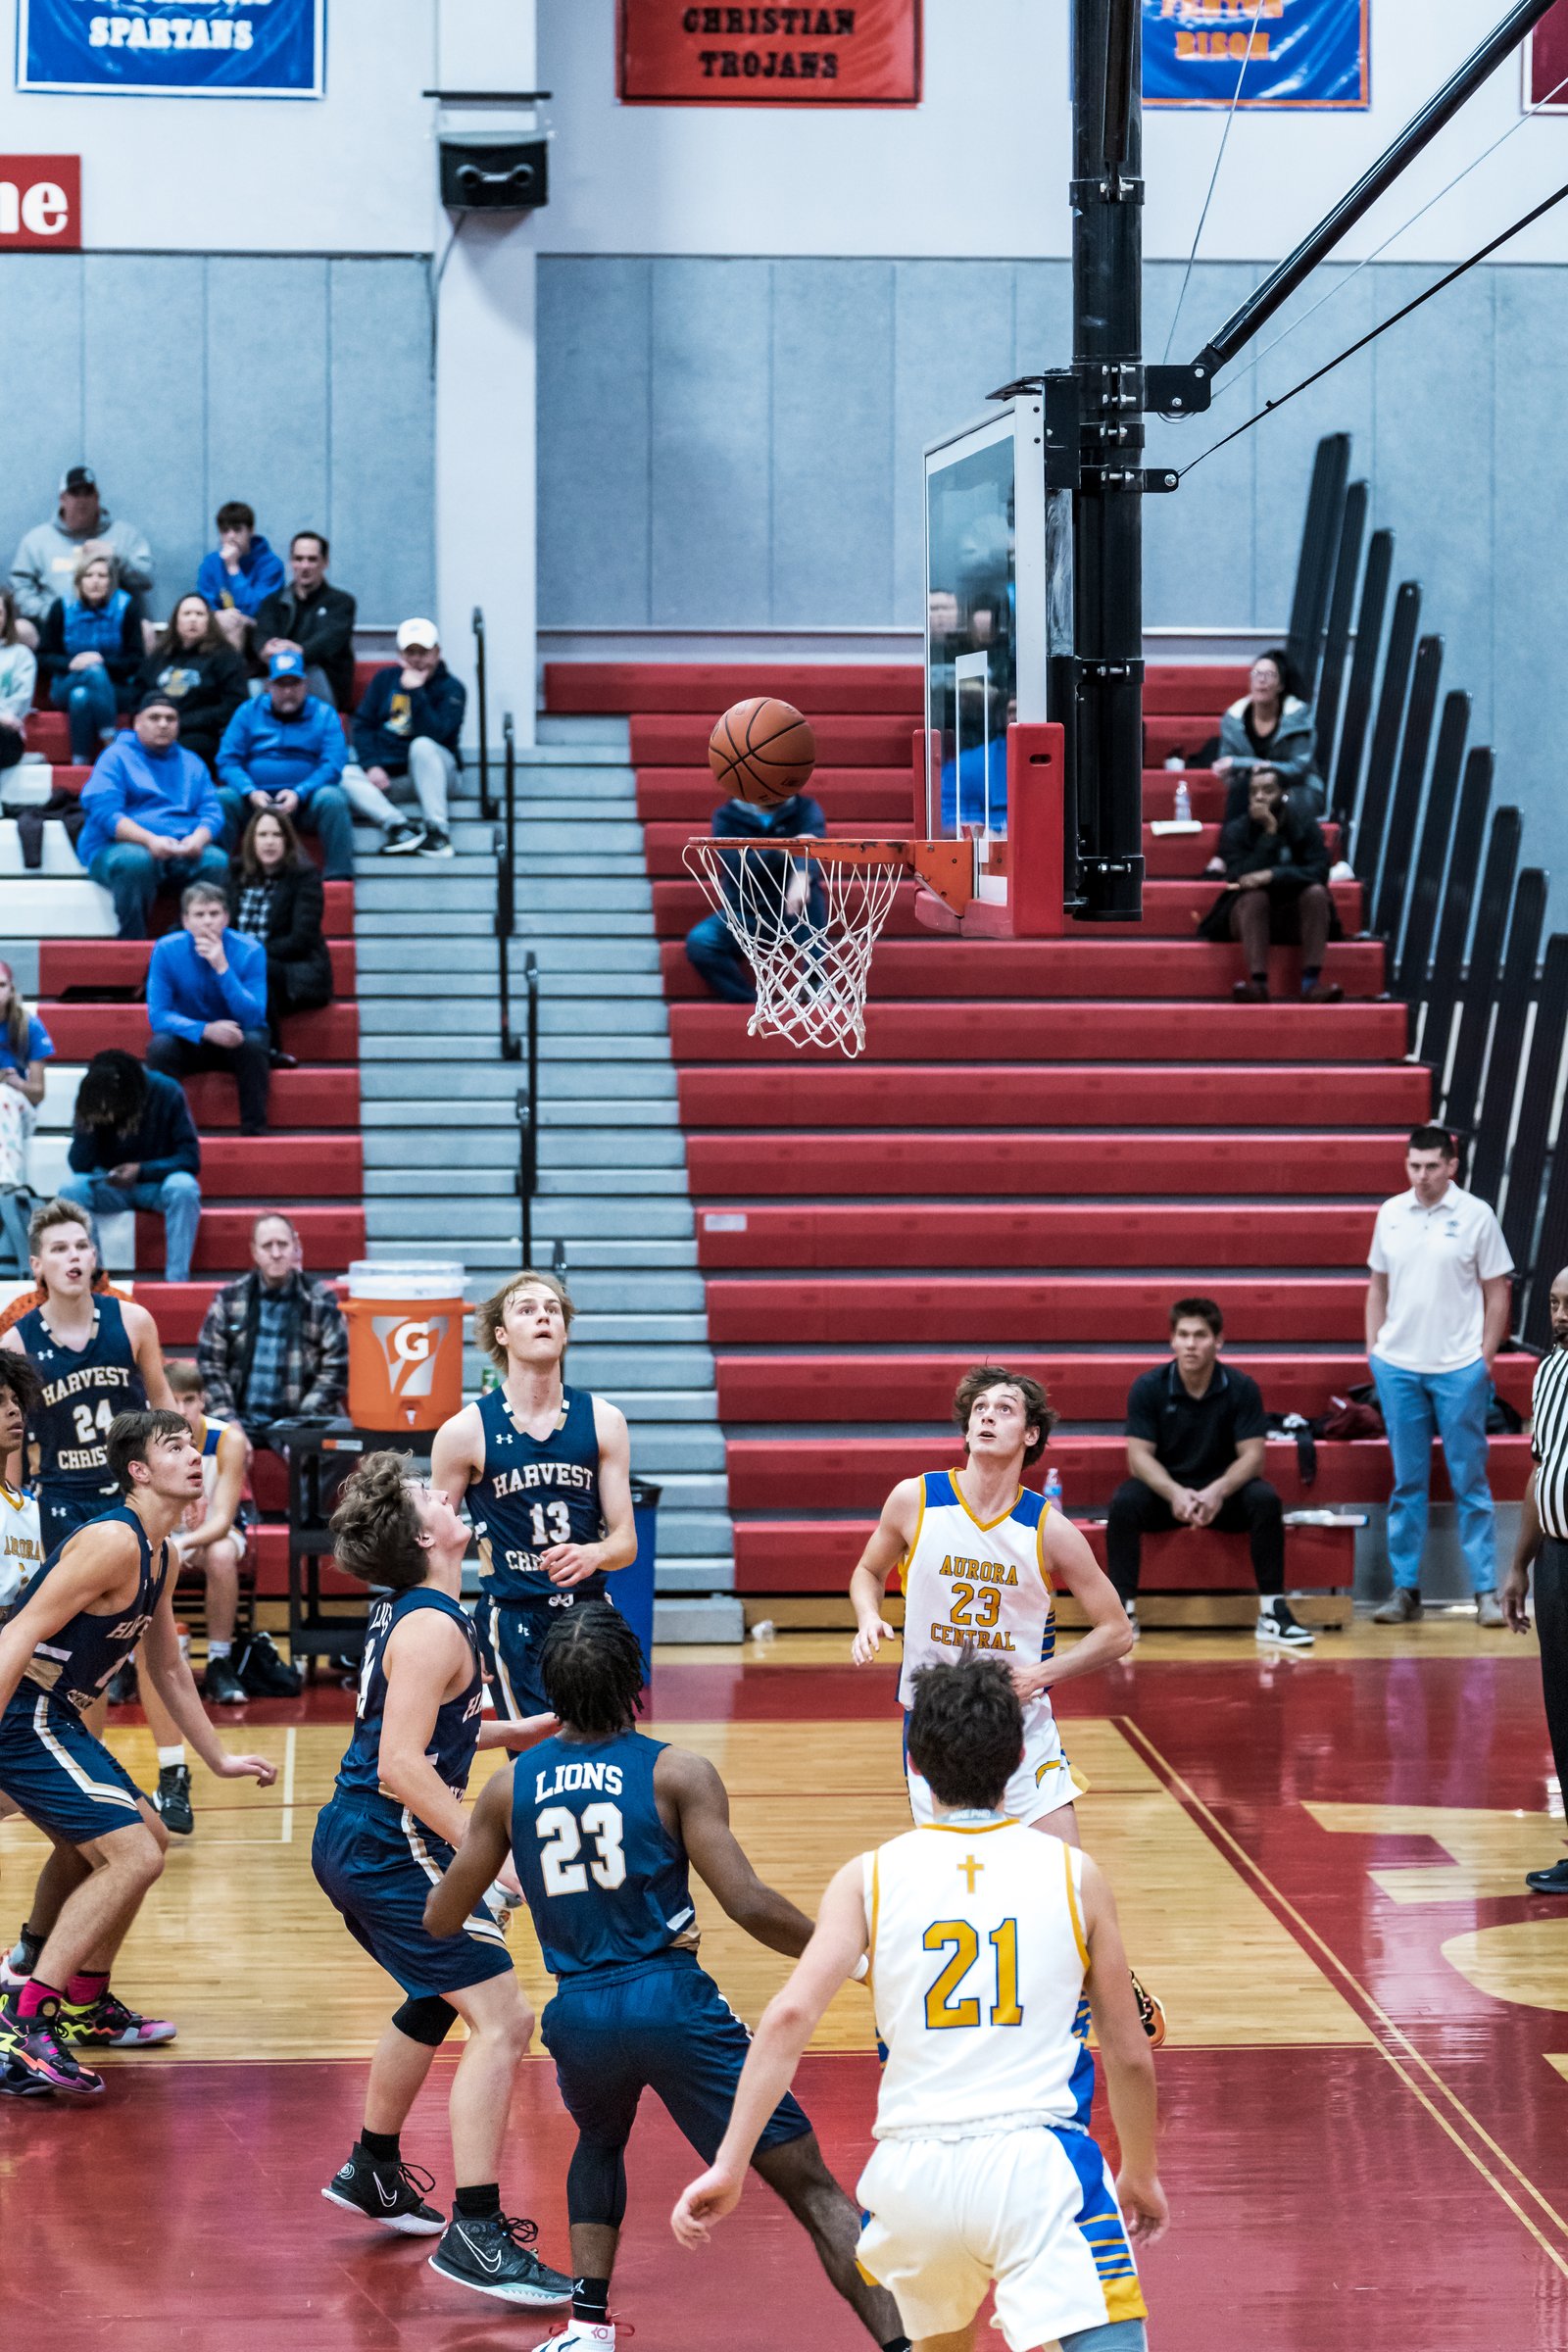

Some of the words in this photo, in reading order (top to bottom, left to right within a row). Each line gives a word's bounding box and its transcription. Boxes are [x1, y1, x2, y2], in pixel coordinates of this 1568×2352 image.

[89, 17, 254, 50] SPARTANS
[682, 7, 855, 35] CHRISTIAN
[699, 51, 839, 78] TROJANS
[394, 1322, 429, 1361] G
[41, 1366, 129, 1407] HARVEST
[73, 1398, 116, 1444] 24
[58, 1446, 108, 1470] CHRIS
[492, 1462, 594, 1498] HARVEST
[529, 1500, 571, 1545] 13
[939, 1554, 1019, 1586] AURORA
[950, 1582, 1002, 1627] 23
[931, 1622, 1016, 1651] CENTRAL
[534, 1762, 623, 1805] LIONS
[535, 1801, 627, 1897] 23
[922, 1917, 1024, 2030] 21
